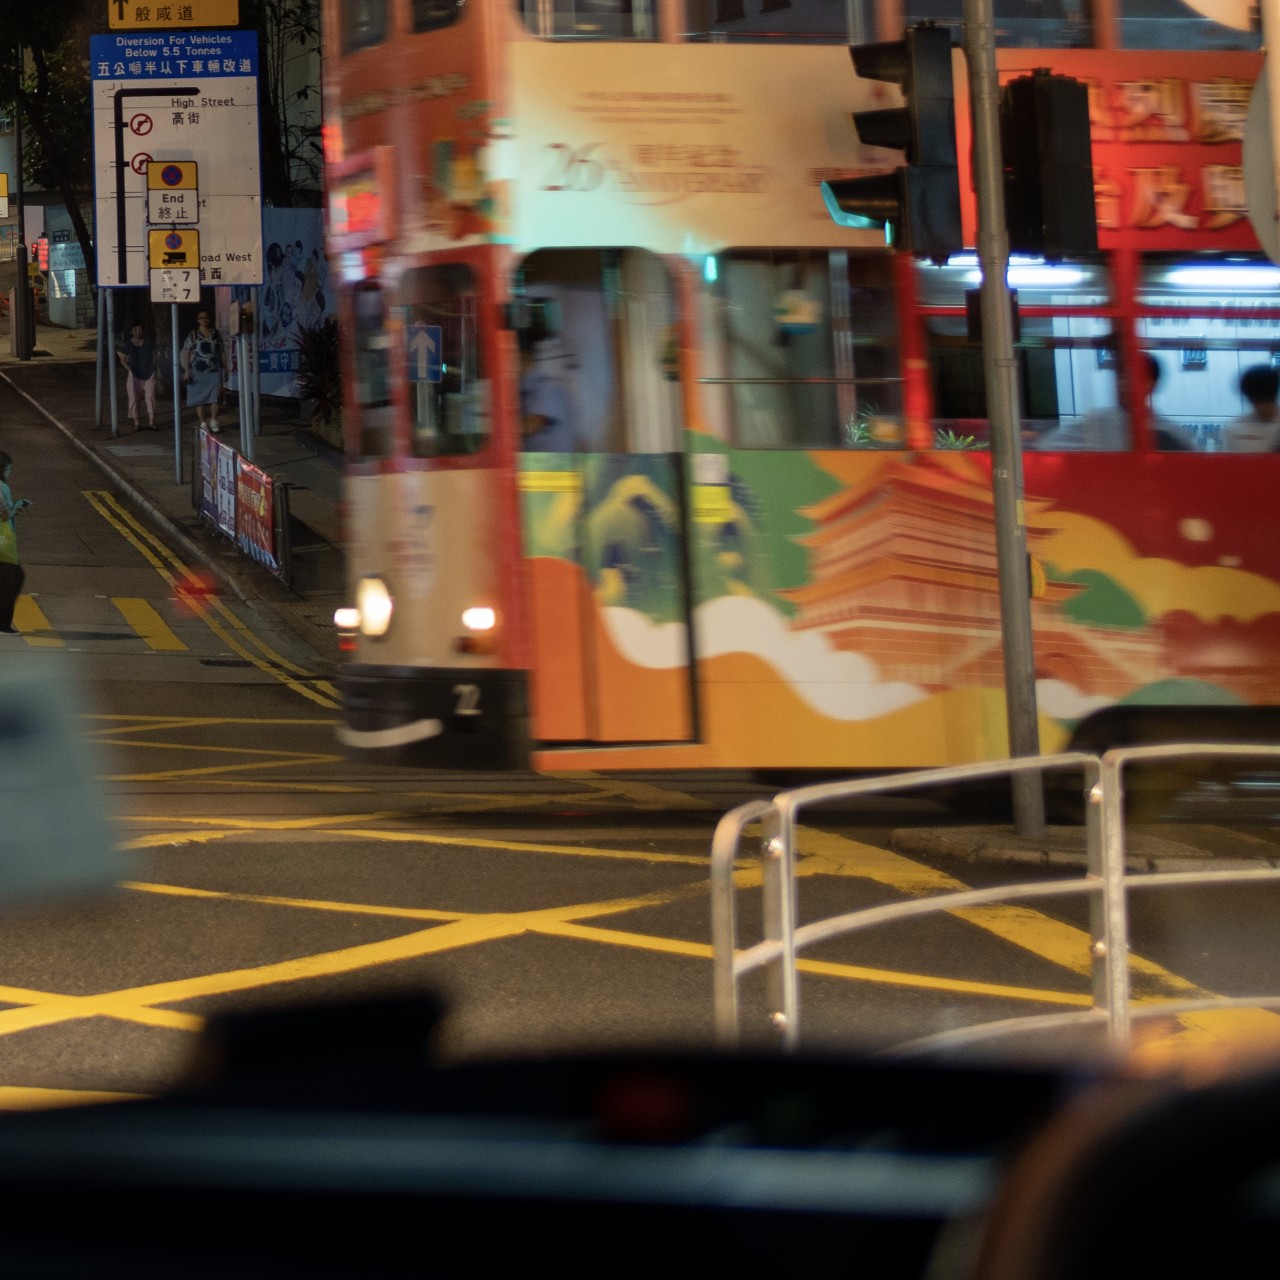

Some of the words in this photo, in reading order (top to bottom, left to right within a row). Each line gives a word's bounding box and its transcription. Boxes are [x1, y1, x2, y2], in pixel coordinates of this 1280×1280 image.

[135, 6, 193, 21] 般咸道
[116, 37, 164, 46] Diversion
[170, 36, 185, 45] For
[190, 35, 232, 44] Vehicles
[125, 48, 157, 57] Below
[163, 47, 180, 56] 5.5
[185, 46, 222, 56] Tonnes
[171, 98, 194, 109] High
[201, 97, 235, 106] Street
[172, 111, 200, 125] 高街
[162, 194, 184, 203] End
[158, 207, 188, 219] 終止
[201, 252, 221, 262] oad
[225, 253, 252, 262] West
[182, 271, 190, 282] 7
[182, 289, 191, 300] 7
